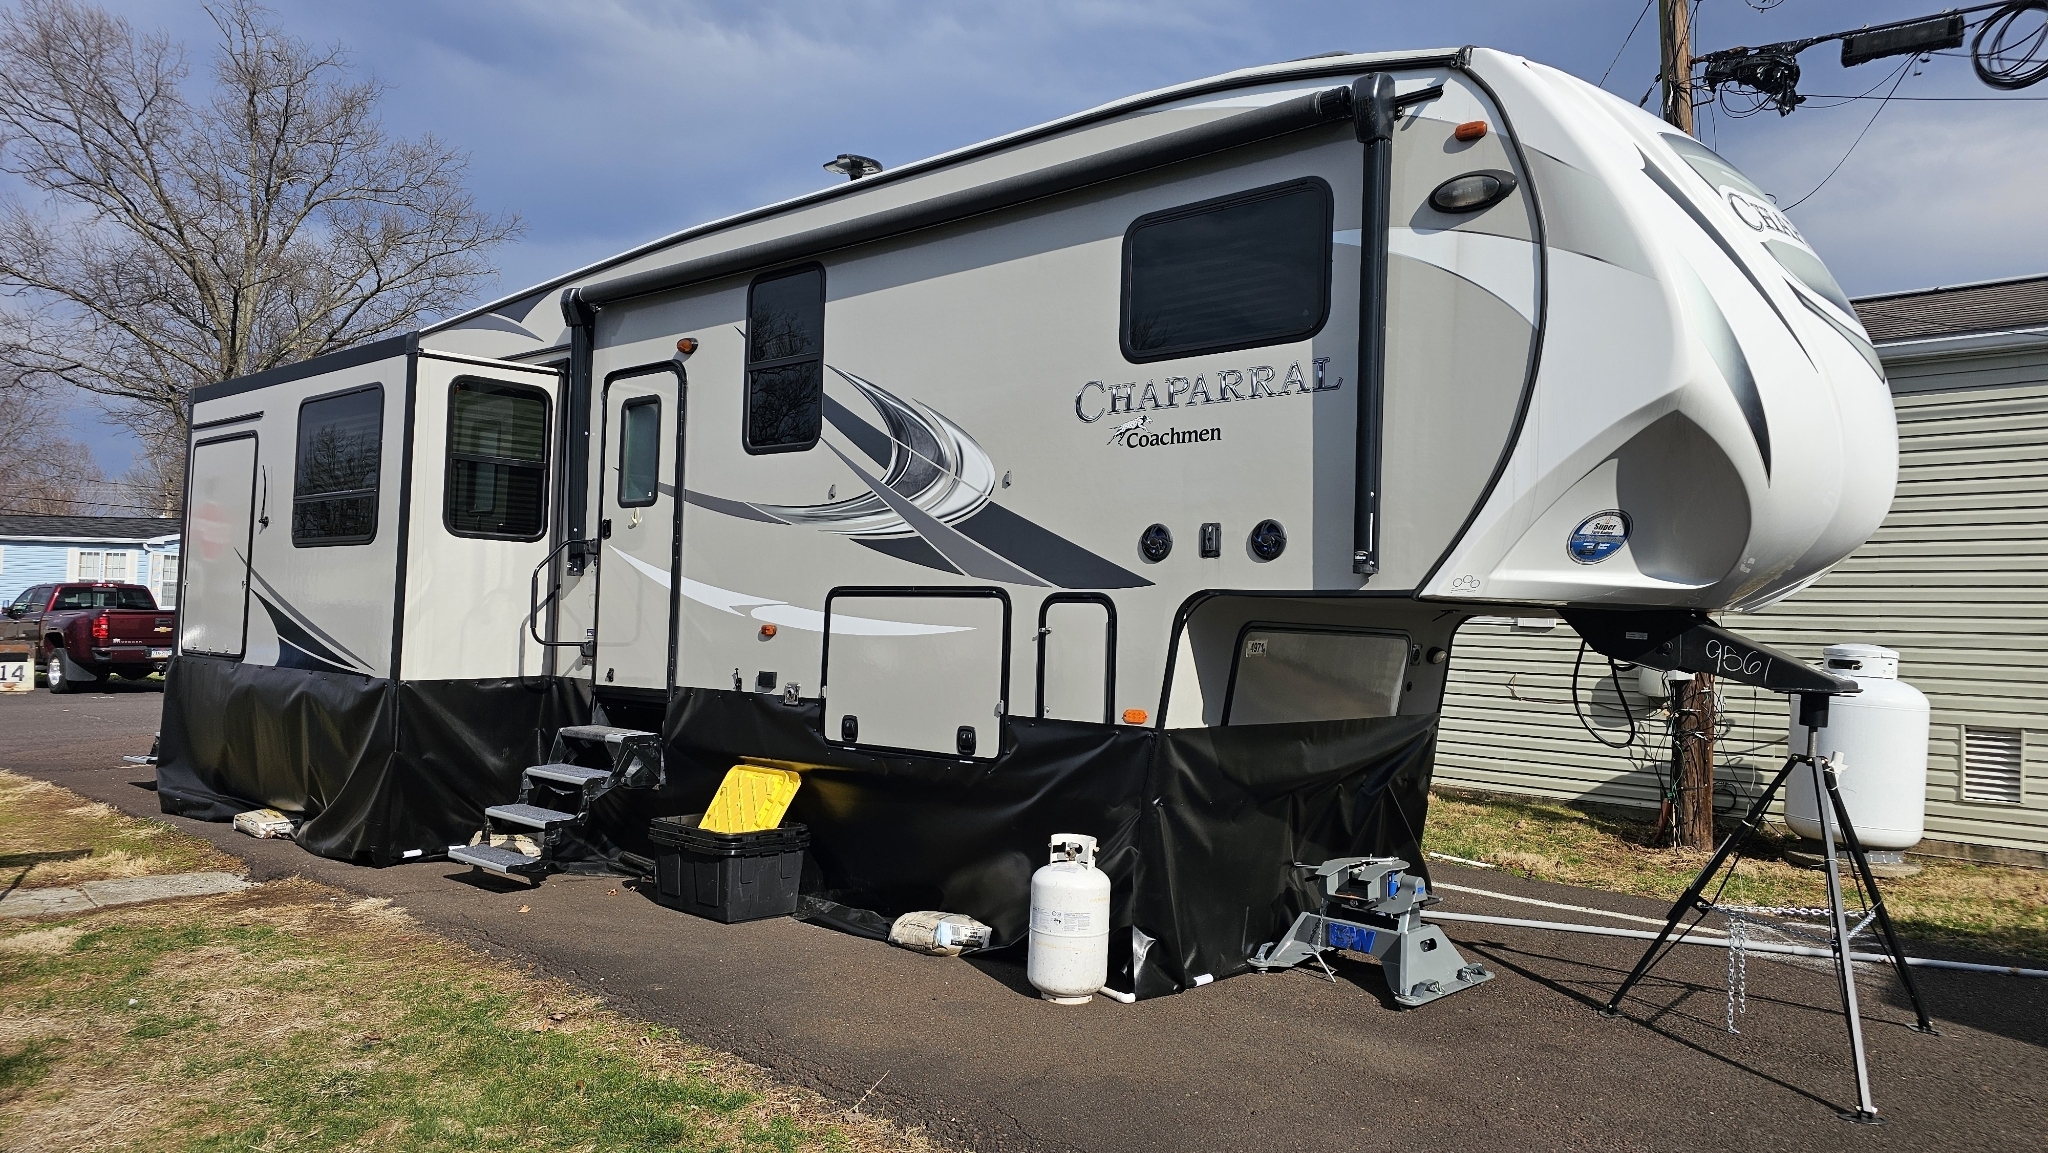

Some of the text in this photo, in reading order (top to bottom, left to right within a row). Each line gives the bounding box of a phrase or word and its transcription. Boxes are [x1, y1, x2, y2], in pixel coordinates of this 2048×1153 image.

[1727, 191, 1808, 247] CHA
[1074, 356, 1344, 424] CHAPARRAL
[1126, 426, 1223, 449] Coachmen
[1593, 522, 1618, 532] Super
[1705, 639, 1773, 686] 9561
